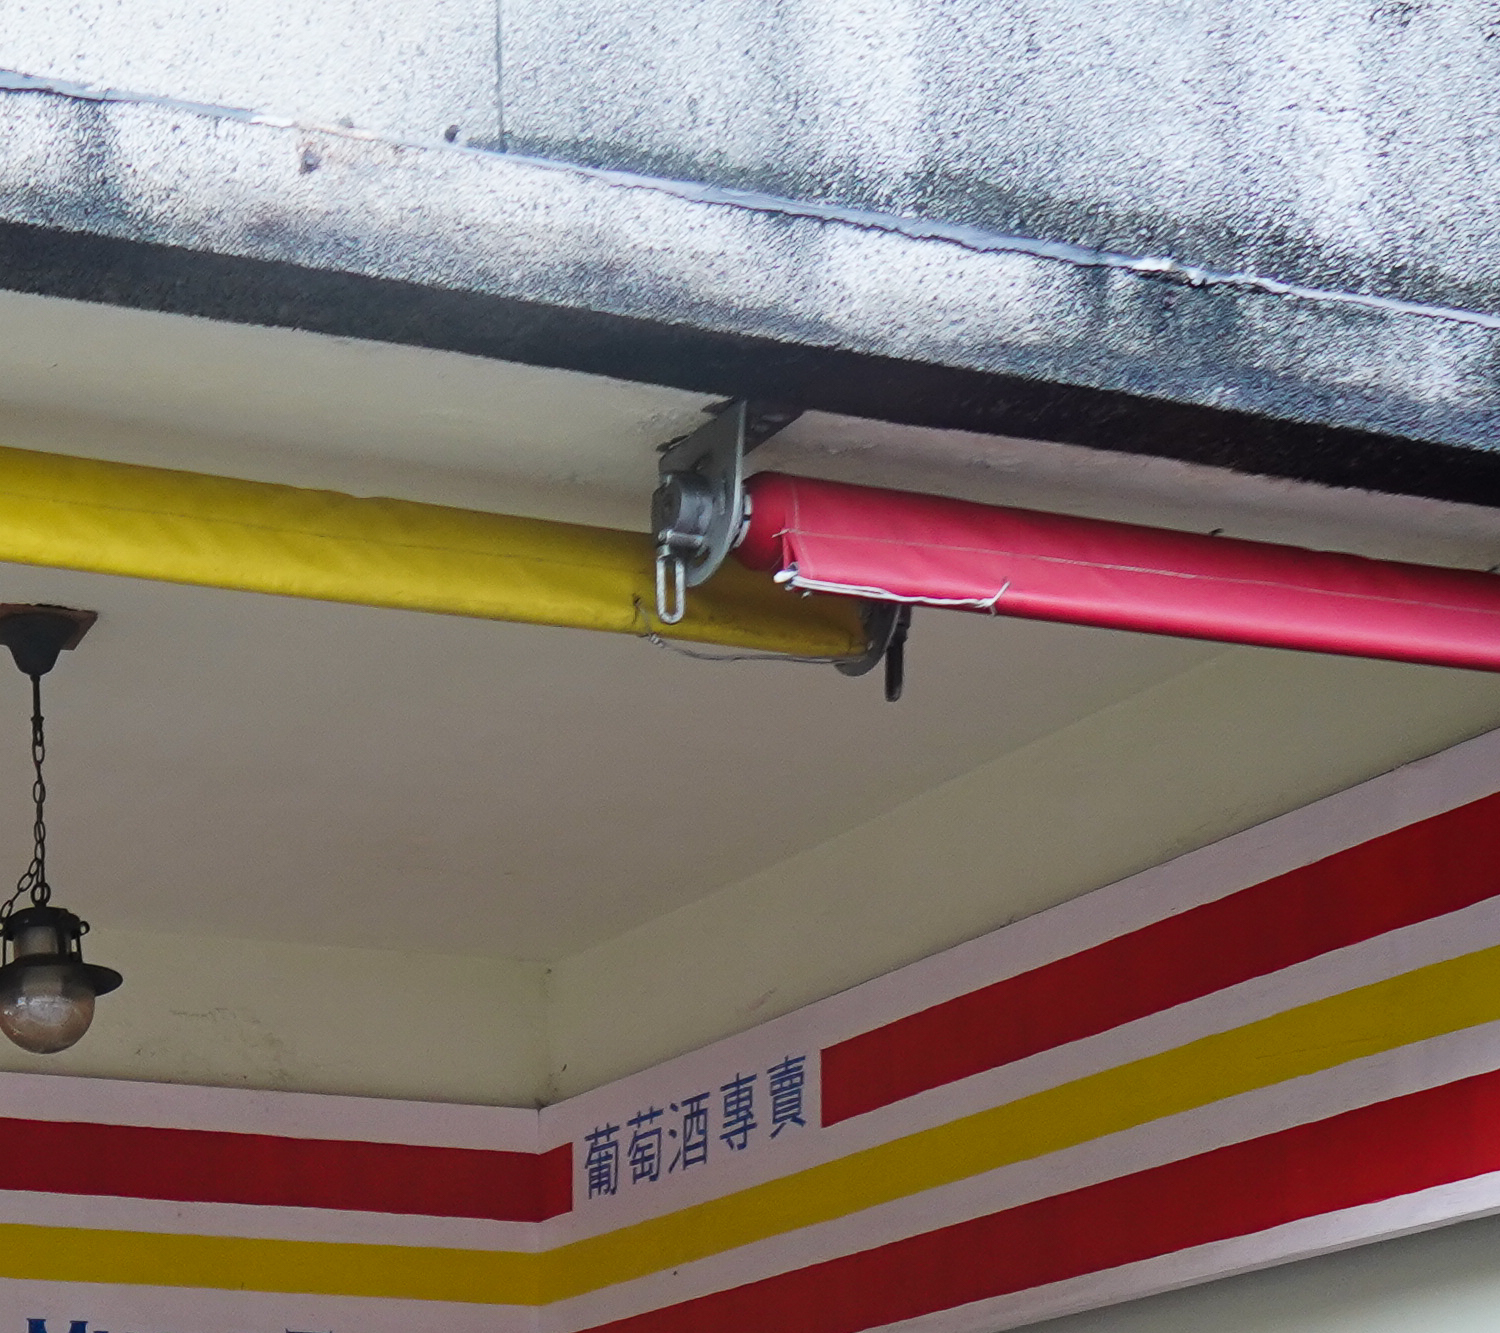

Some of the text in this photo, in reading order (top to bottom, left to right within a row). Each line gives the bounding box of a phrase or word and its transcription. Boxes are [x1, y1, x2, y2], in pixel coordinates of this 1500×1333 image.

[584, 1055, 807, 1199] 葡萄酒專賣
